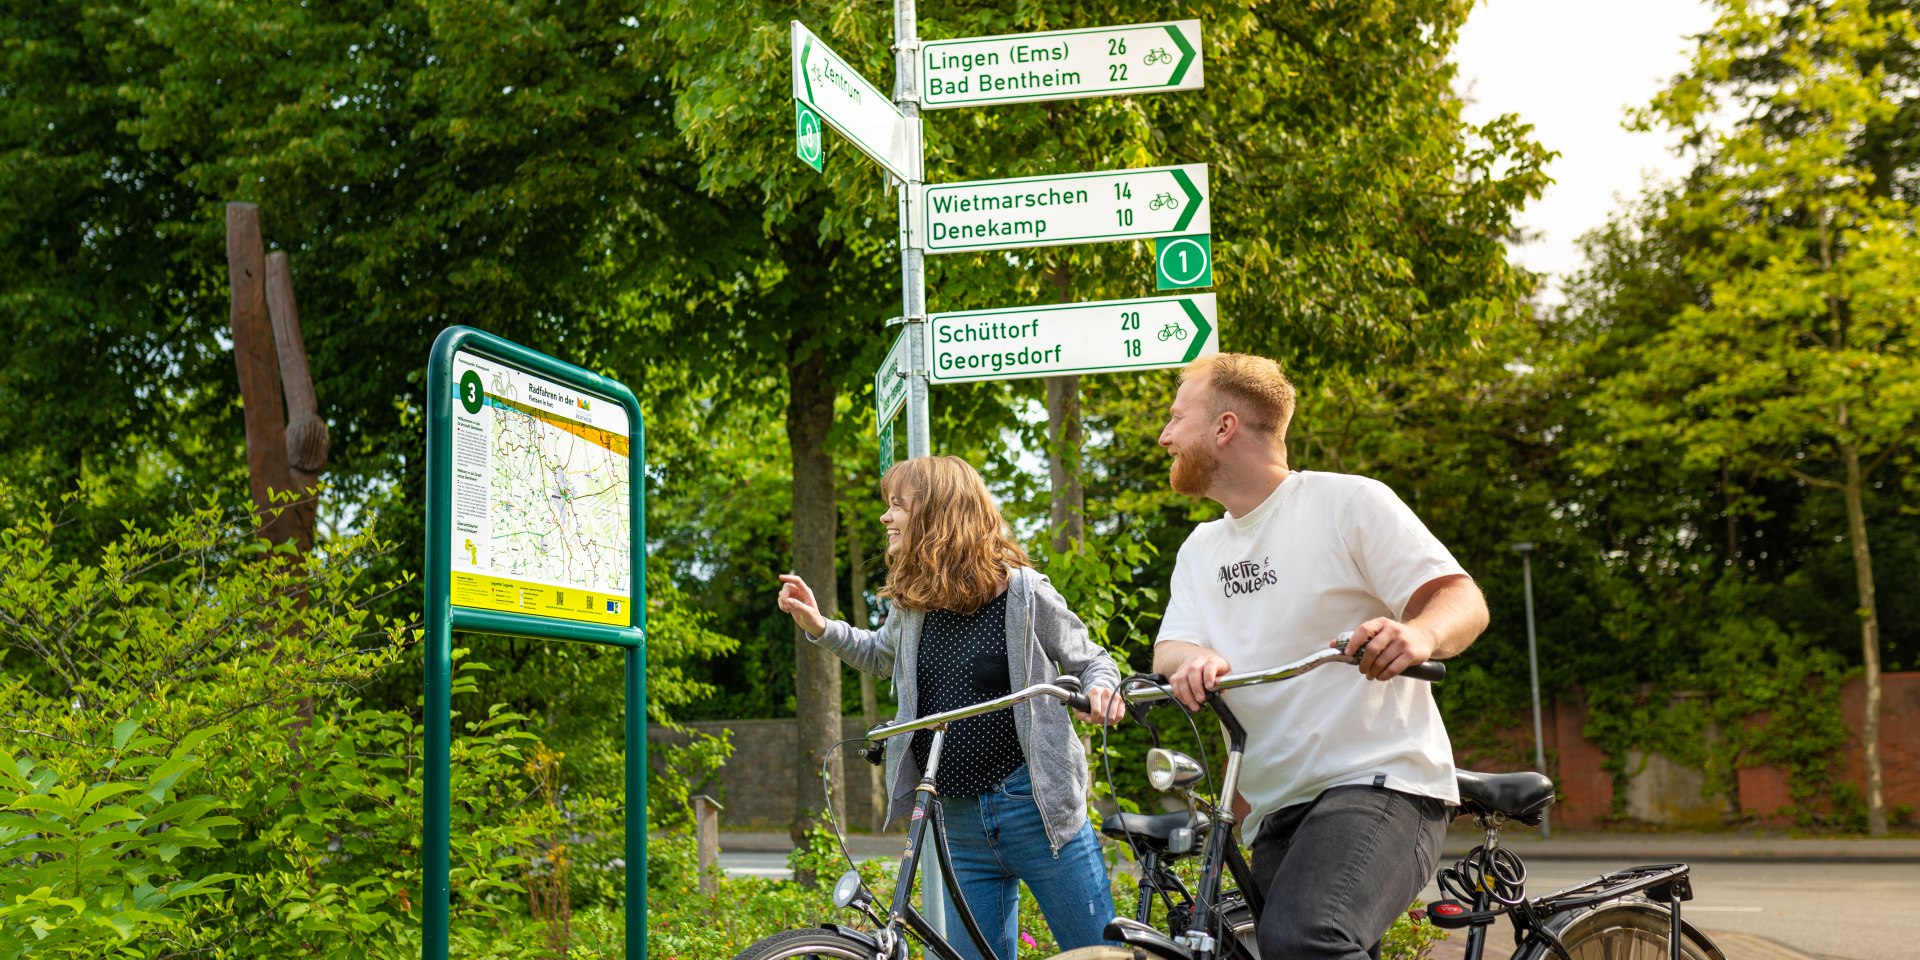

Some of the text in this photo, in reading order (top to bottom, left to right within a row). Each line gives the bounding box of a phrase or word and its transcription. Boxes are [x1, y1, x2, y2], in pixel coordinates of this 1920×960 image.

[929, 37, 1127, 72] Lingen (Ems) 26
[823, 58, 862, 106] Zentrum
[930, 63, 1128, 96] Bad Bentheim 22
[933, 181, 1132, 214] Wietmarschen 14
[933, 208, 1134, 241] Denekamp 10
[1178, 250, 1188, 273] 1
[939, 311, 1140, 343] Schüttorf 20
[939, 338, 1142, 372] Georgsdorf 18
[467, 382, 476, 403] 3
[528, 382, 574, 406] Radfahren in der
